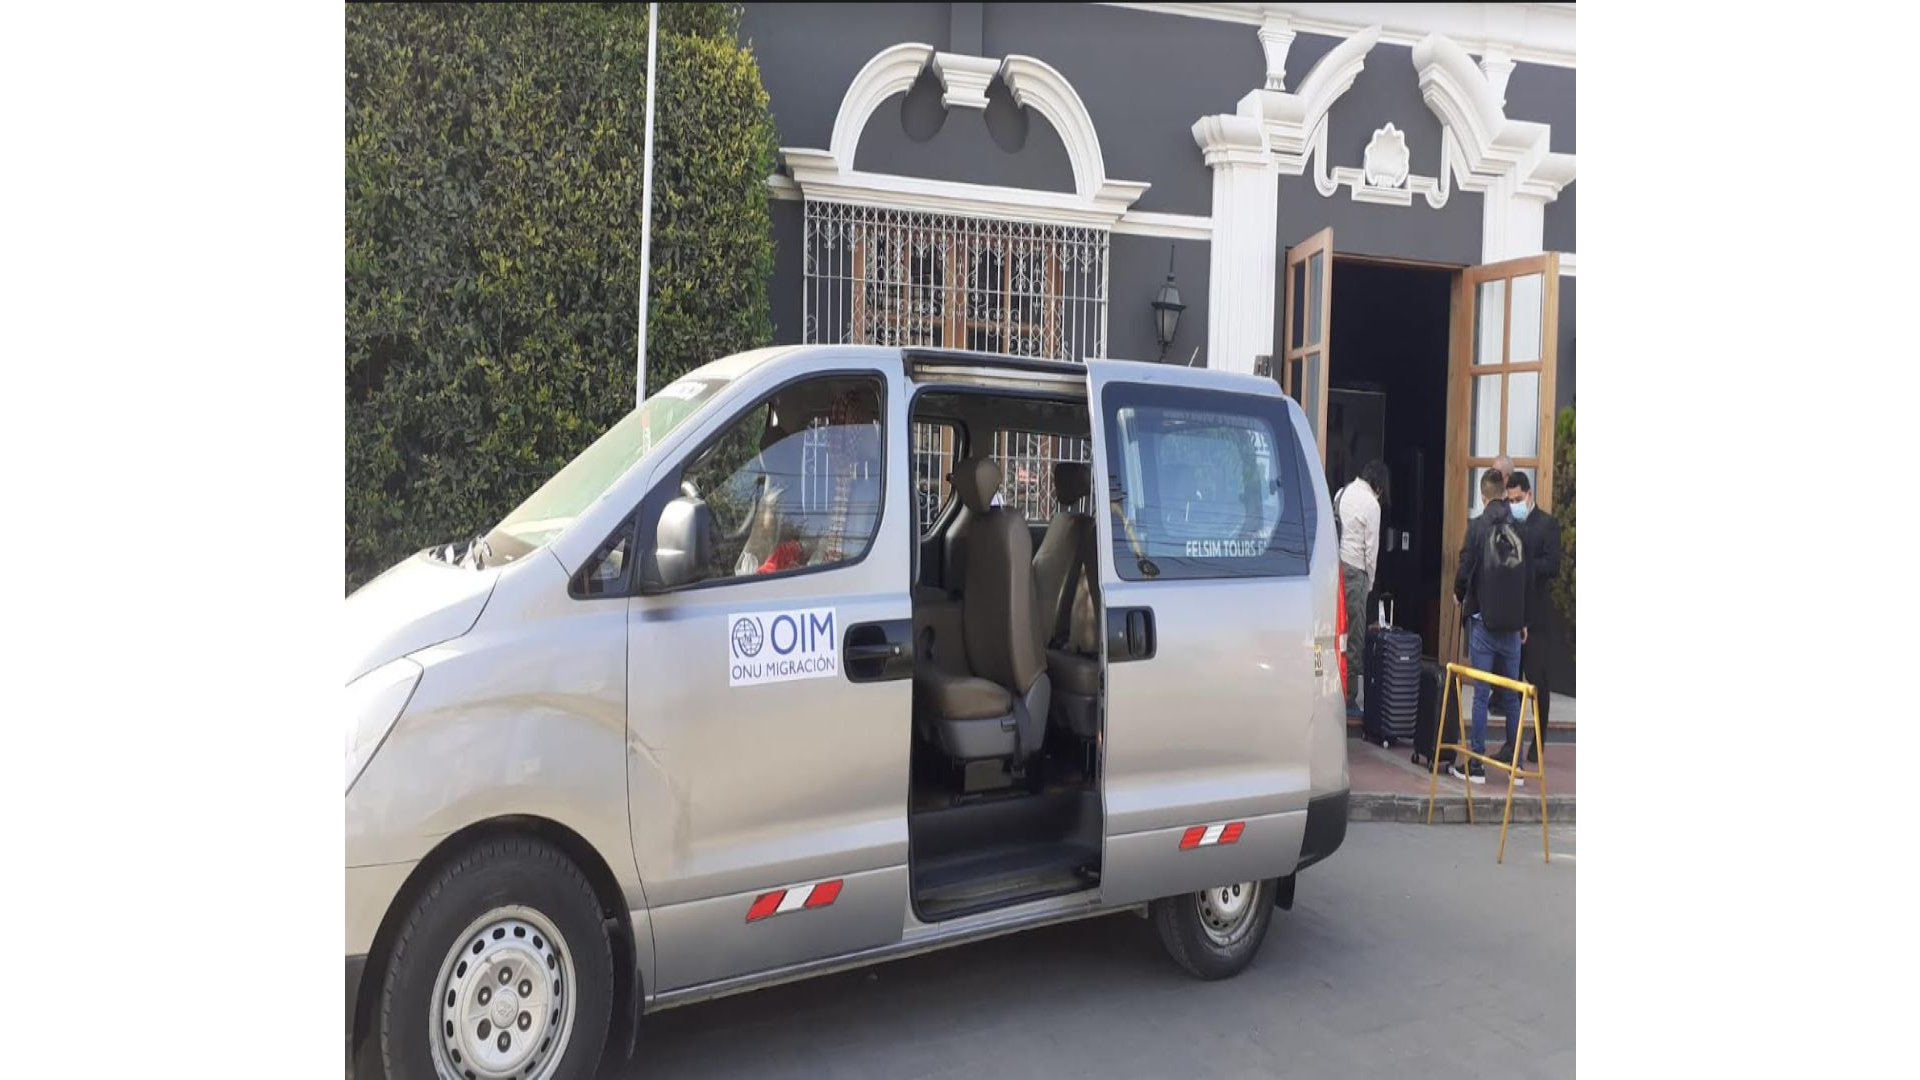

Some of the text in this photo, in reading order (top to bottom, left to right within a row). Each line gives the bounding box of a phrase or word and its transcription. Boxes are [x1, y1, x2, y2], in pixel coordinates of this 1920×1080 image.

[1186, 540, 1221, 557] FELSIM
[1224, 540, 1256, 557] TOURS
[771, 612, 834, 655] OIM
[732, 654, 835, 680] ONU MIGRACIÓN
